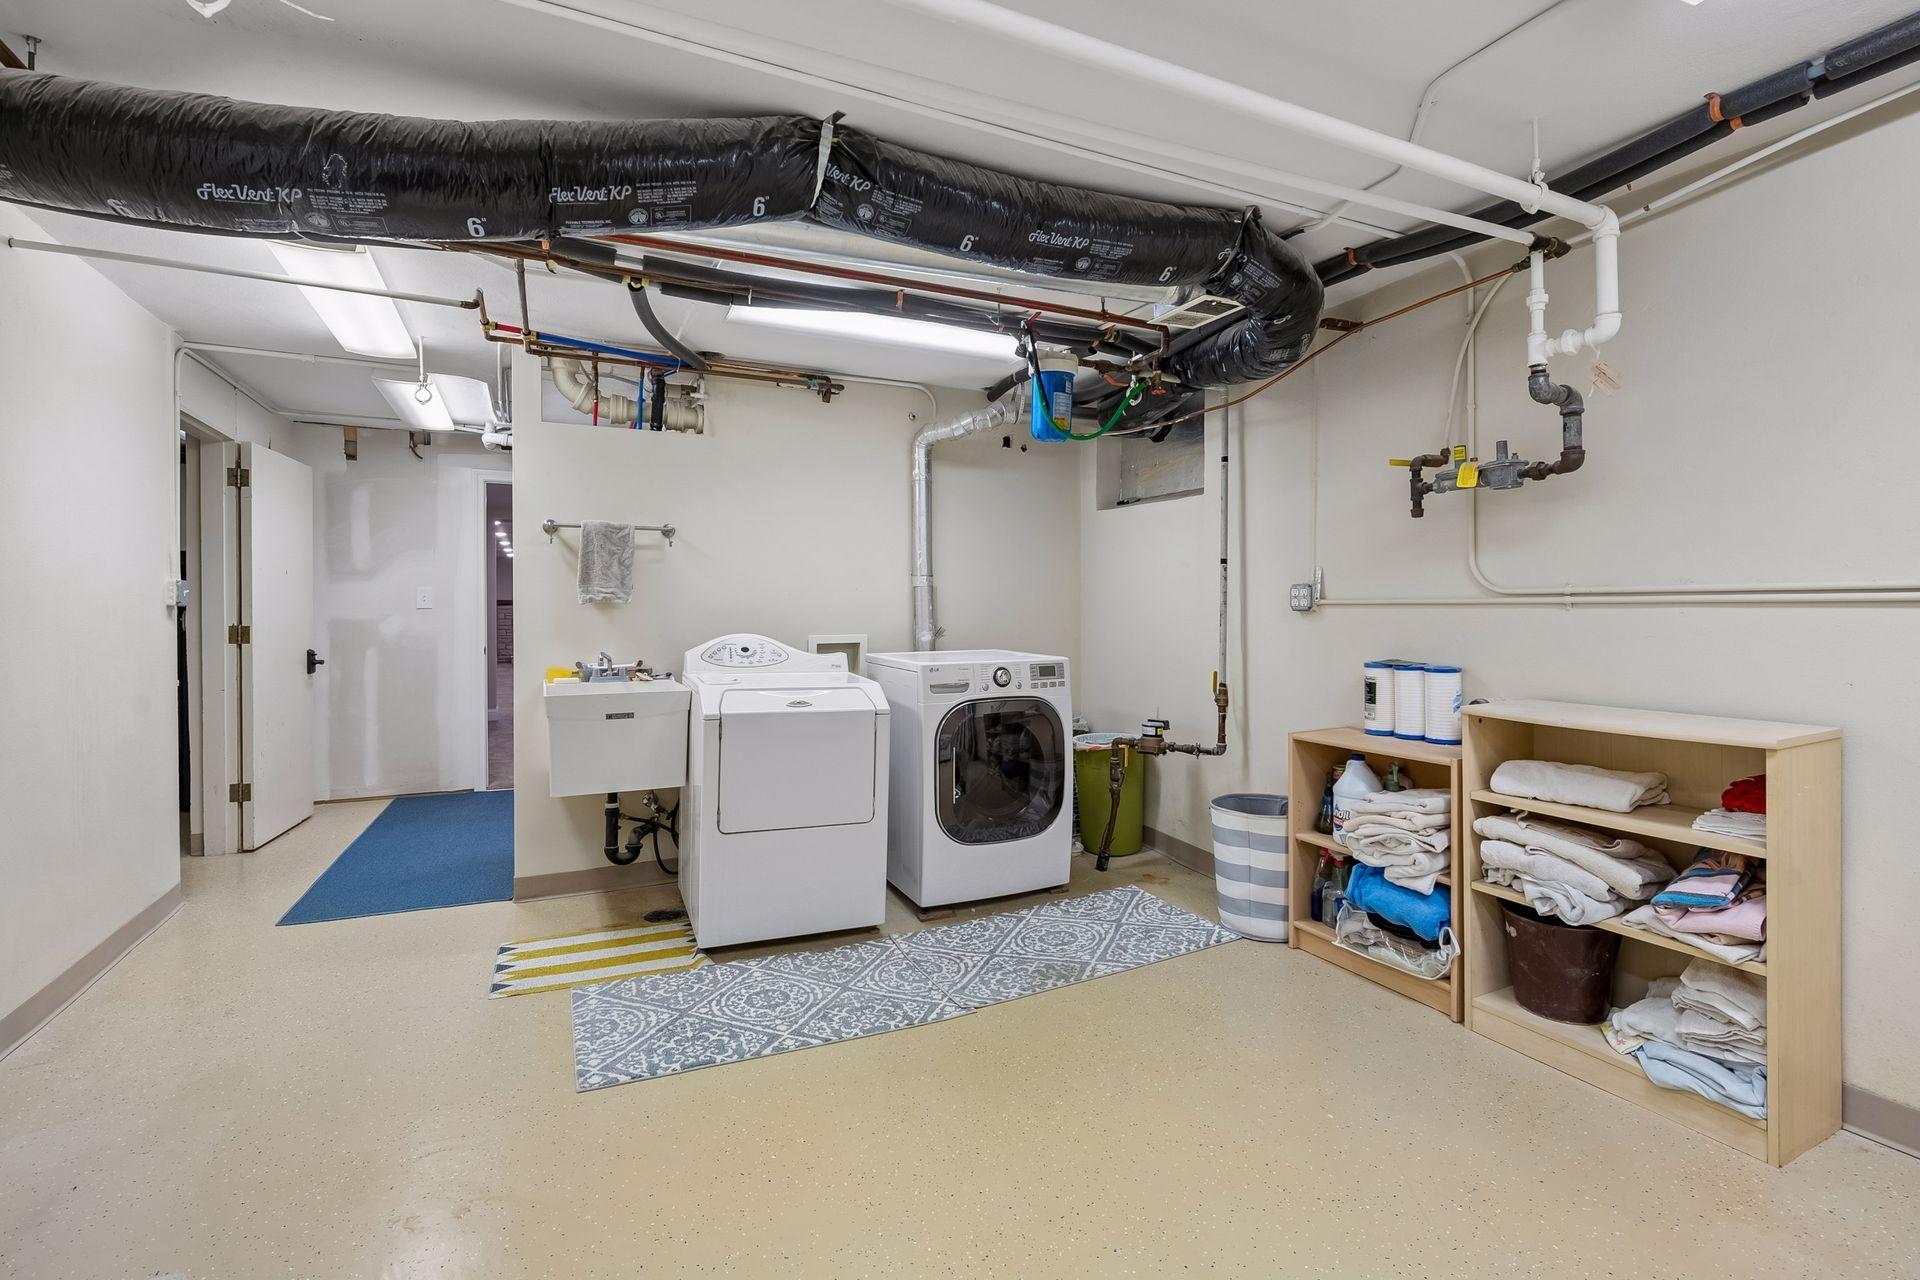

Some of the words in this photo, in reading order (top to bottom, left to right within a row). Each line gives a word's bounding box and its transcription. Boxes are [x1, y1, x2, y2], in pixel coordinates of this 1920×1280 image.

[826, 162, 850, 186] Vent
[849, 175, 871, 192] KP
[196, 182, 235, 200] Flex
[231, 184, 276, 202] Vent
[275, 186, 303, 204] KP
[548, 187, 575, 204] Flex
[574, 185, 608, 202] Vent
[608, 184, 632, 200] KP
[1028, 229, 1051, 244] Flex
[1050, 231, 1073, 248] Vent
[1071, 236, 1090, 249] KP
